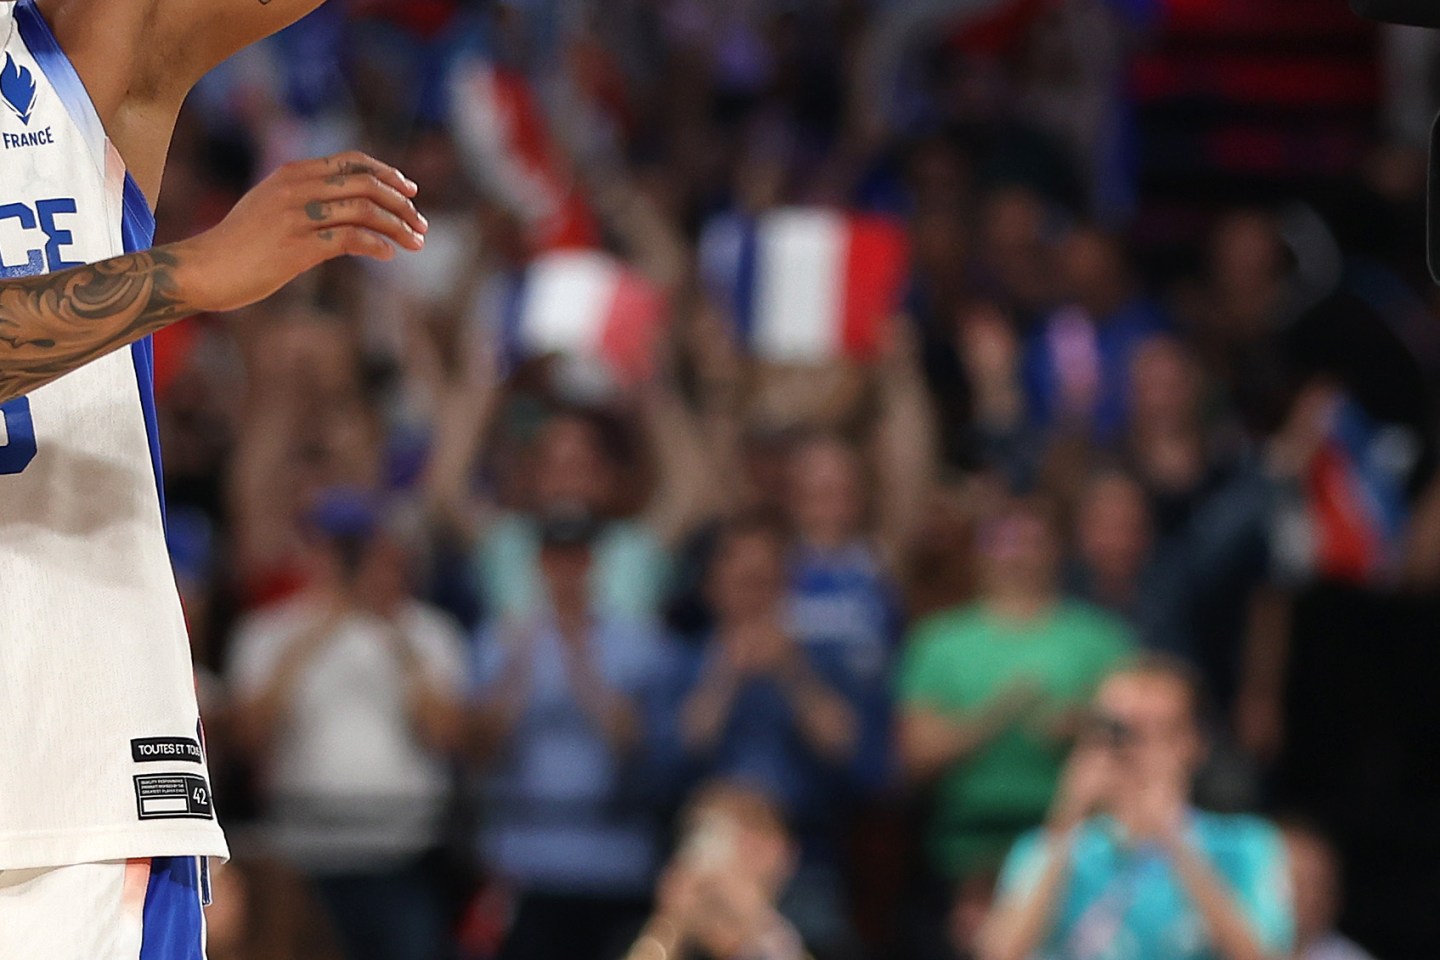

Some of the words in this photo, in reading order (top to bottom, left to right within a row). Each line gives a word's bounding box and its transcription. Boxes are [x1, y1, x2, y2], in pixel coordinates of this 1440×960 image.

[2, 126, 54, 149] FRANCE
[138, 744, 175, 755] TOUTES
[176, 744, 185, 755] ET
[193, 787, 208, 805] 42
